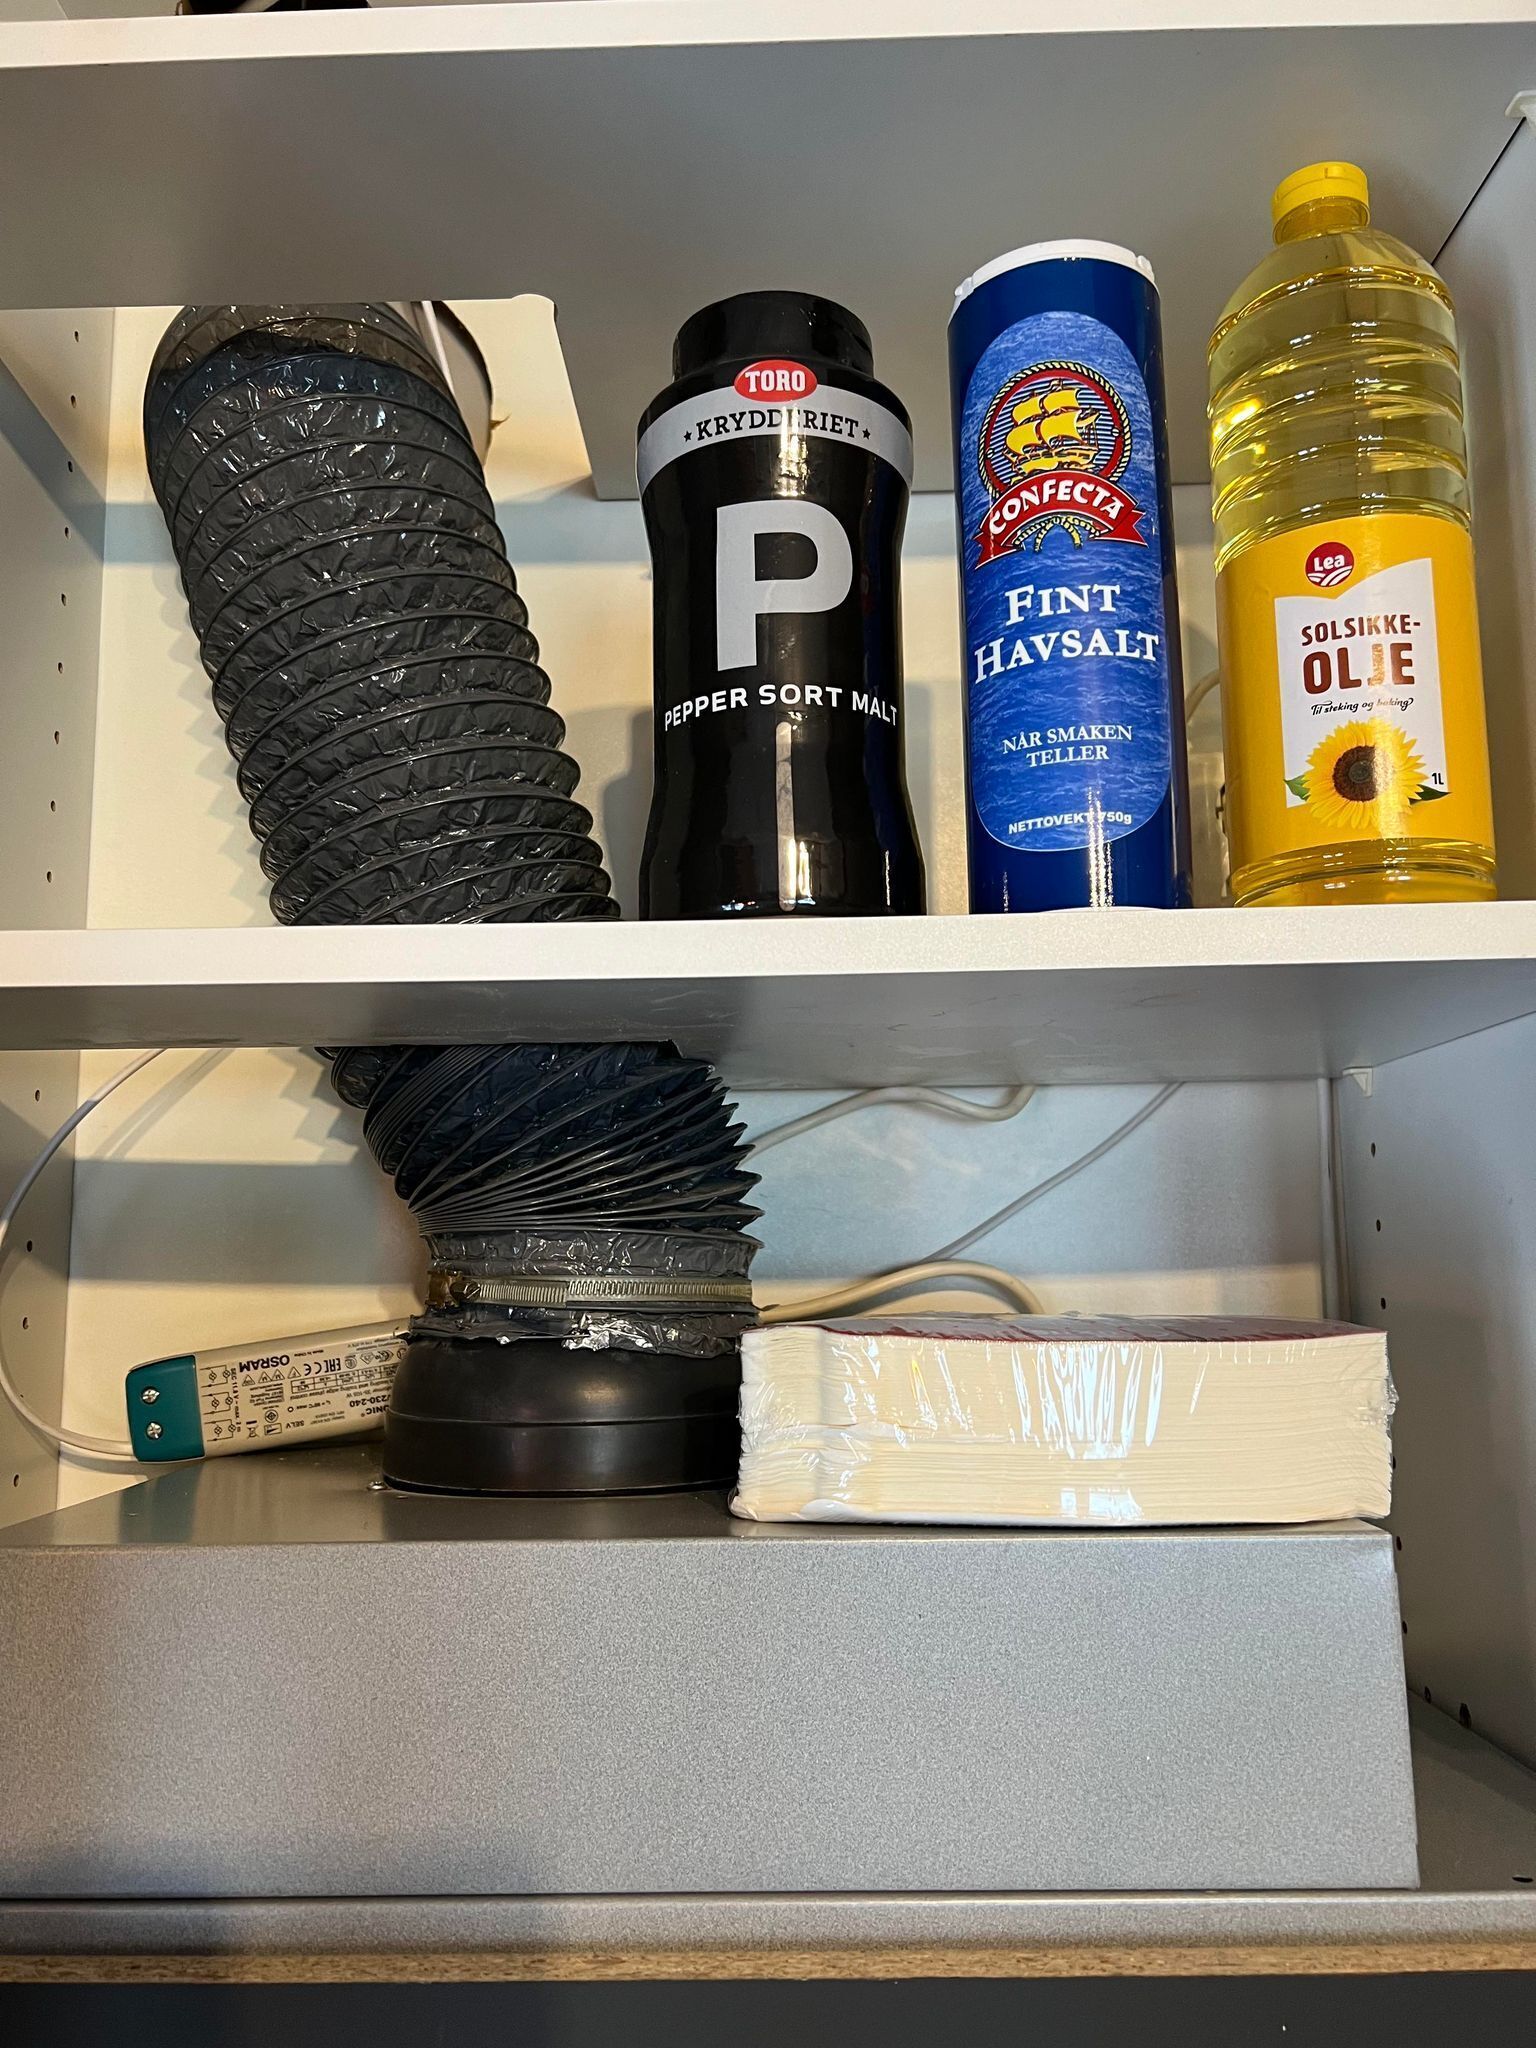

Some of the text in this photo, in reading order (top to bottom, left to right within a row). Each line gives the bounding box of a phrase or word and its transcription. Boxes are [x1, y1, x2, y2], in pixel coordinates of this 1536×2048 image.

[744, 368, 807, 394] TORO
[696, 409, 859, 441] KRYDDERIET
[988, 479, 1125, 536] CONFECTA
[1313, 552, 1346, 572] Lea
[715, 500, 854, 673] P
[1004, 583, 1121, 626] FINT
[1300, 614, 1422, 647] SOLSIKKE-
[974, 628, 1160, 685] HAVSALT
[1302, 642, 1416, 695] OLJE
[663, 683, 899, 732] PEPPER SORT MALT
[1323, 700, 1359, 714] steking
[1361, 700, 1375, 711] og
[1001, 724, 1133, 755] NÅR SMAKEN
[1026, 744, 1110, 768] TELLER
[1431, 772, 1445, 786] 1L
[1008, 813, 1092, 835] NETTOVEKT
[239, 1355, 291, 1373] OSRAM
[285, 1419, 305, 1429] SELV
